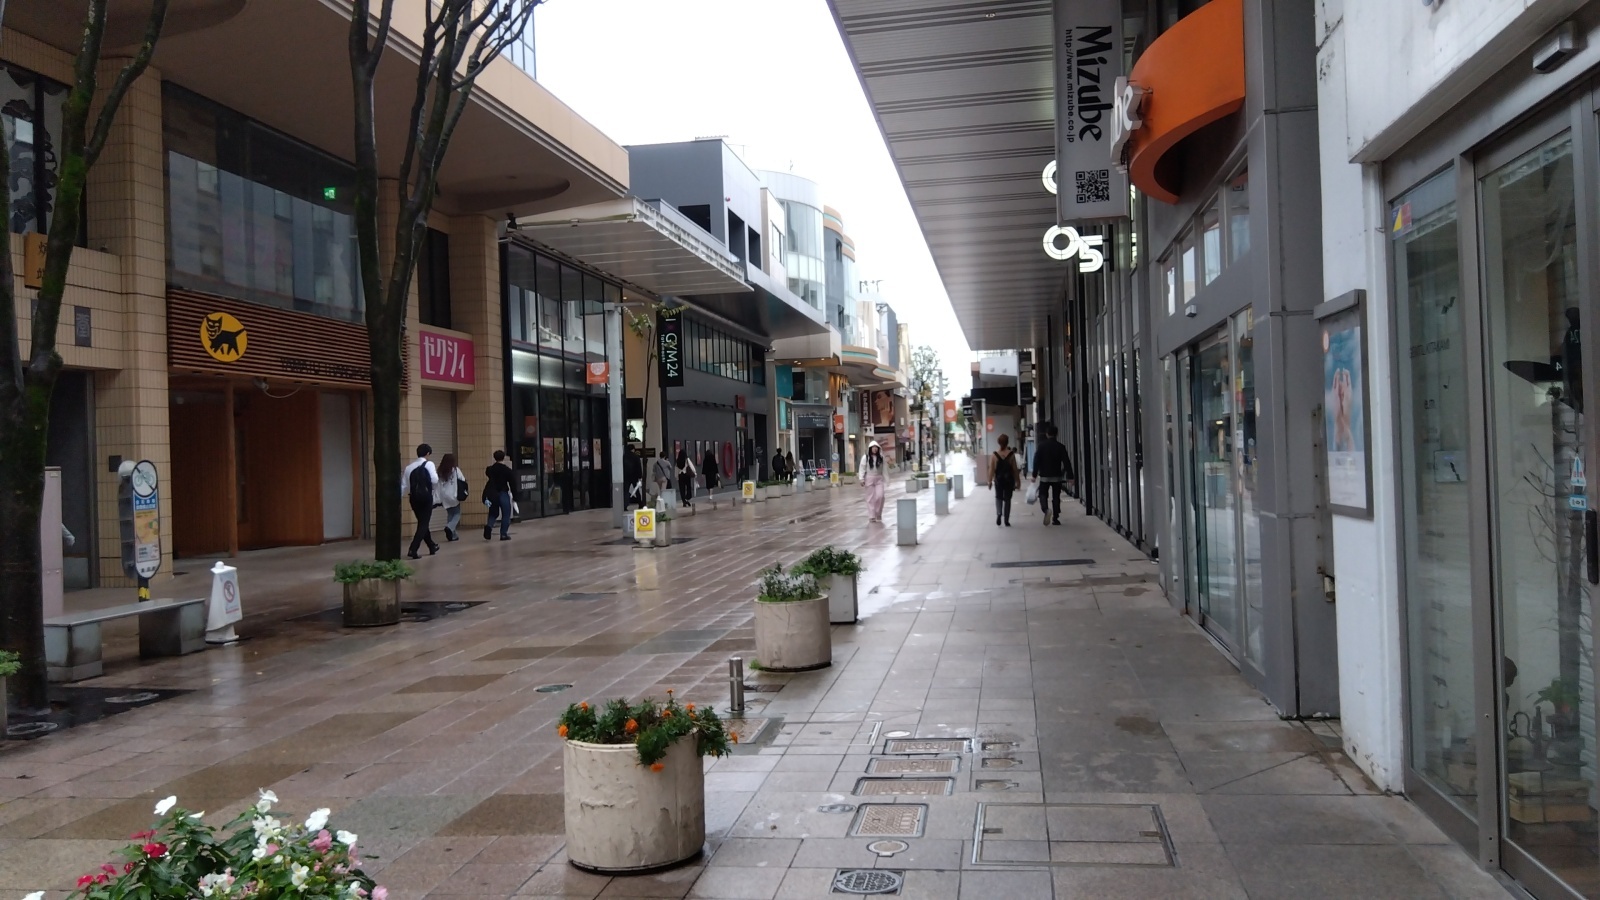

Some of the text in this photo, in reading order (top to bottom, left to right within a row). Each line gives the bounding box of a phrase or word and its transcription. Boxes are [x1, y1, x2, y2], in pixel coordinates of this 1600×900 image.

[1064, 29, 1076, 143] http://www.mizube.co.jp
[1076, 26, 1113, 142] Mizube
[423, 336, 465, 379] ゼクシィ
[666, 333, 678, 377] GYM24
